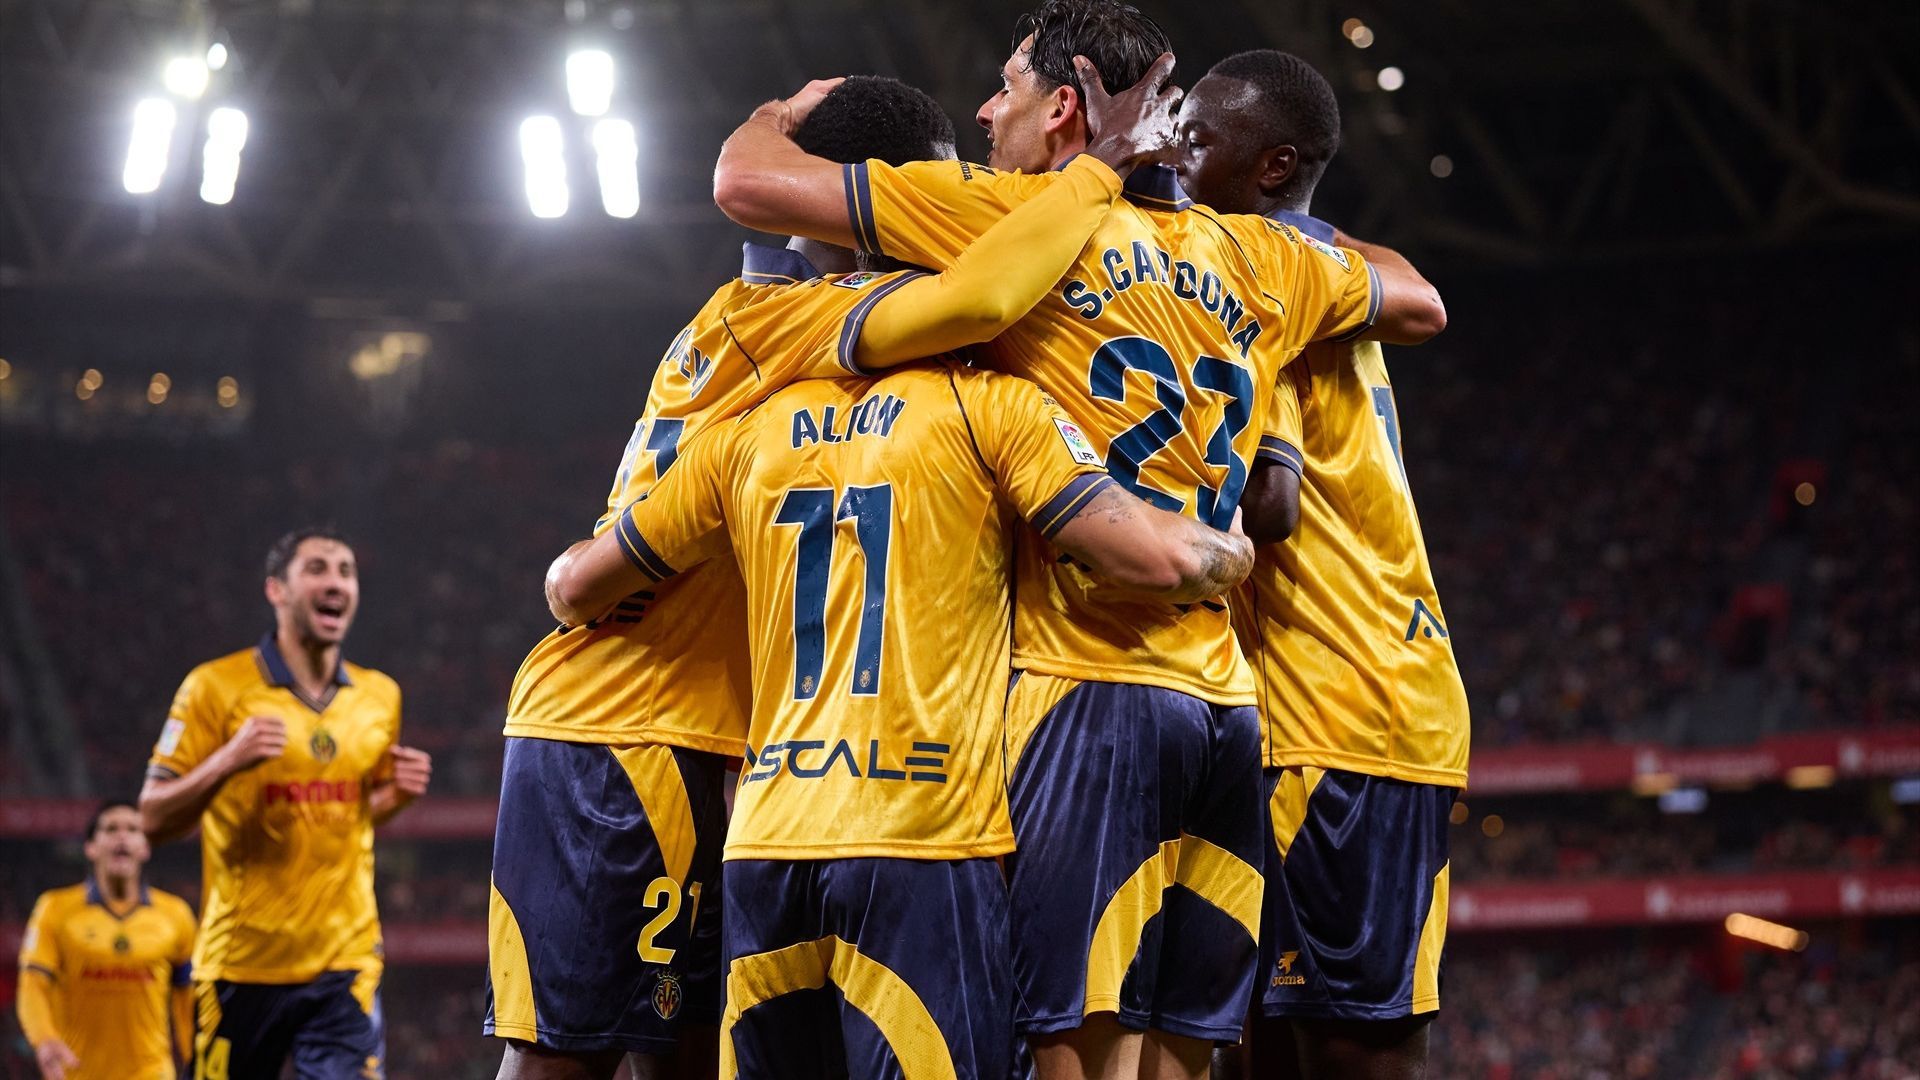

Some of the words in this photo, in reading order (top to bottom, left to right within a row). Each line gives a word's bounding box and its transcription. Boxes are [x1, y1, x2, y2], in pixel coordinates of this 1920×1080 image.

[771, 482, 893, 702] 11
[266, 780, 360, 805] PAME
[637, 876, 702, 965] 21
